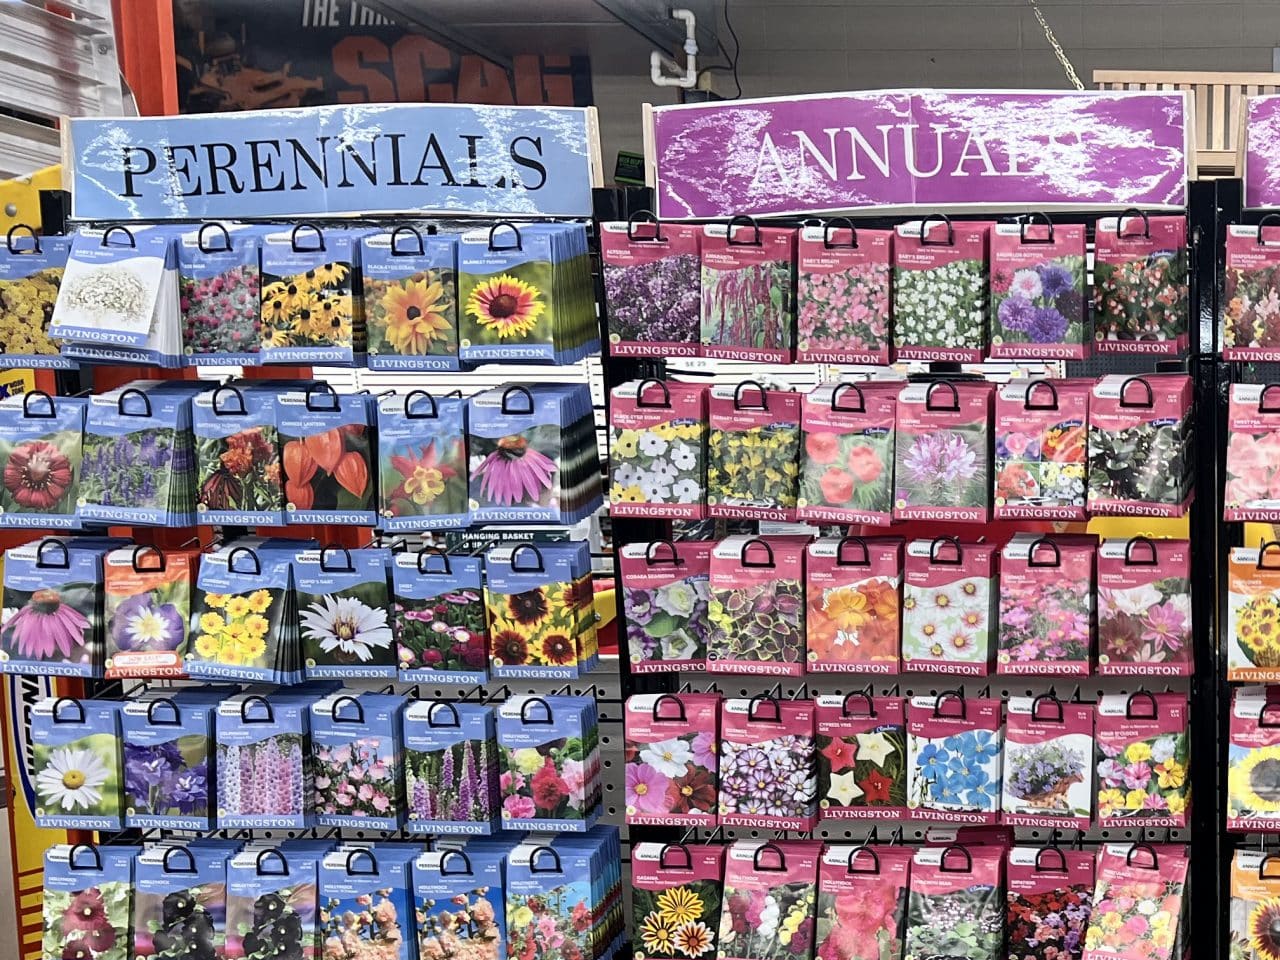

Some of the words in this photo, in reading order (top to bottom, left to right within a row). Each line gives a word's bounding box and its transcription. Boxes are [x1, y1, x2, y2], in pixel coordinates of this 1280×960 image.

[121, 133, 548, 198] PERENNIALS
[53, 328, 139, 344] LIVINGSTON
[1098, 343, 1169, 353] LIVINGSTON
[706, 350, 782, 362] LIVINGSTON
[898, 351, 972, 361] LIVINGSTON
[373, 357, 450, 369] LIVINGSTON
[711, 508, 787, 520] LIVINGSTON
[1091, 503, 1169, 517] LIVINGSTON
[201, 515, 273, 524] LIVINGSTON
[473, 511, 550, 521] LIVINGSTON
[900, 511, 978, 521] LIVINGSTON
[388, 519, 461, 529] LIVINGSTON
[462, 532, 500, 540] HANGING
[502, 532, 534, 540] BASKET
[187, 666, 264, 680] LIVINGSTON
[712, 664, 791, 674] LIVINGSTON
[907, 664, 979, 674] LIVINGSTON
[1104, 665, 1181, 675] LIVINGSTON
[499, 670, 570, 679] LIVINGSTON
[911, 811, 986, 822] LIVINGSTON
[130, 819, 201, 829] LIVINGSTON
[319, 817, 388, 828] LIVINGSTON
[506, 821, 578, 831] LIVINGSTON
[722, 819, 800, 829] LIVINGSTON
[1104, 818, 1177, 828] LIVINGSTON
